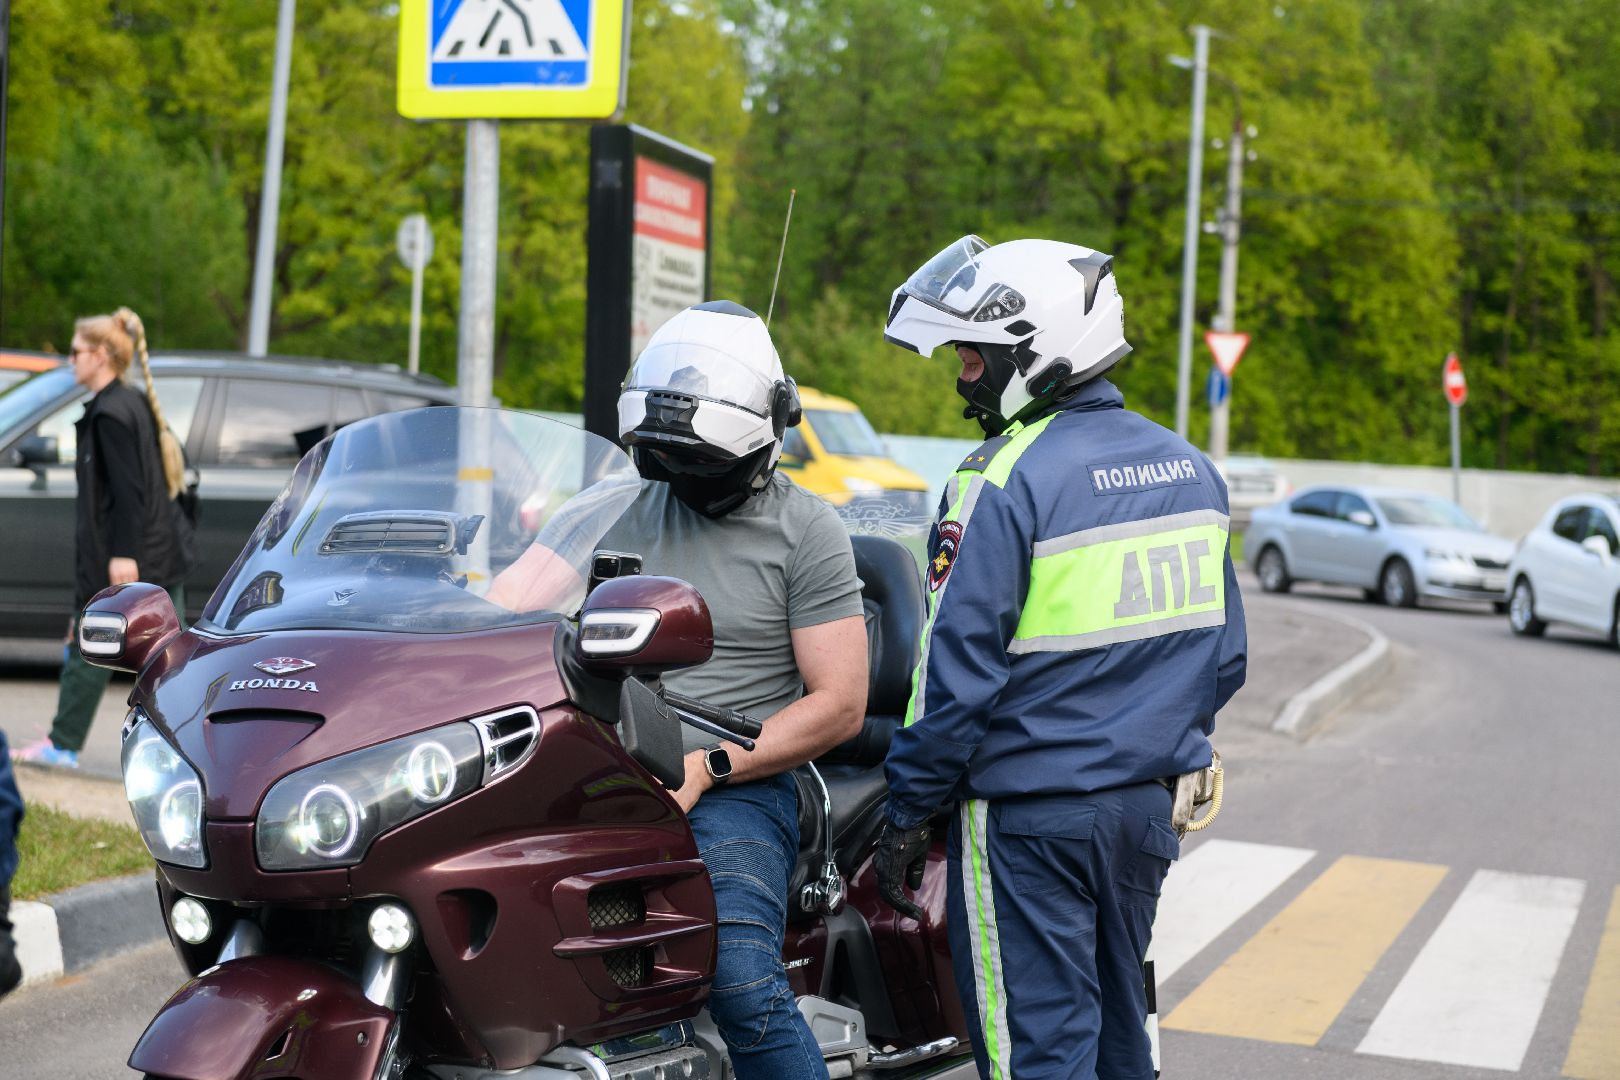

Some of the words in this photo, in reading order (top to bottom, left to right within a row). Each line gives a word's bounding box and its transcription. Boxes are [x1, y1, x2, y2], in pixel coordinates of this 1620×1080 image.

[1093, 460, 1196, 490] ПОЛИЦИЯ
[1114, 539, 1215, 619] ДПС
[229, 678, 319, 693] HONDA
